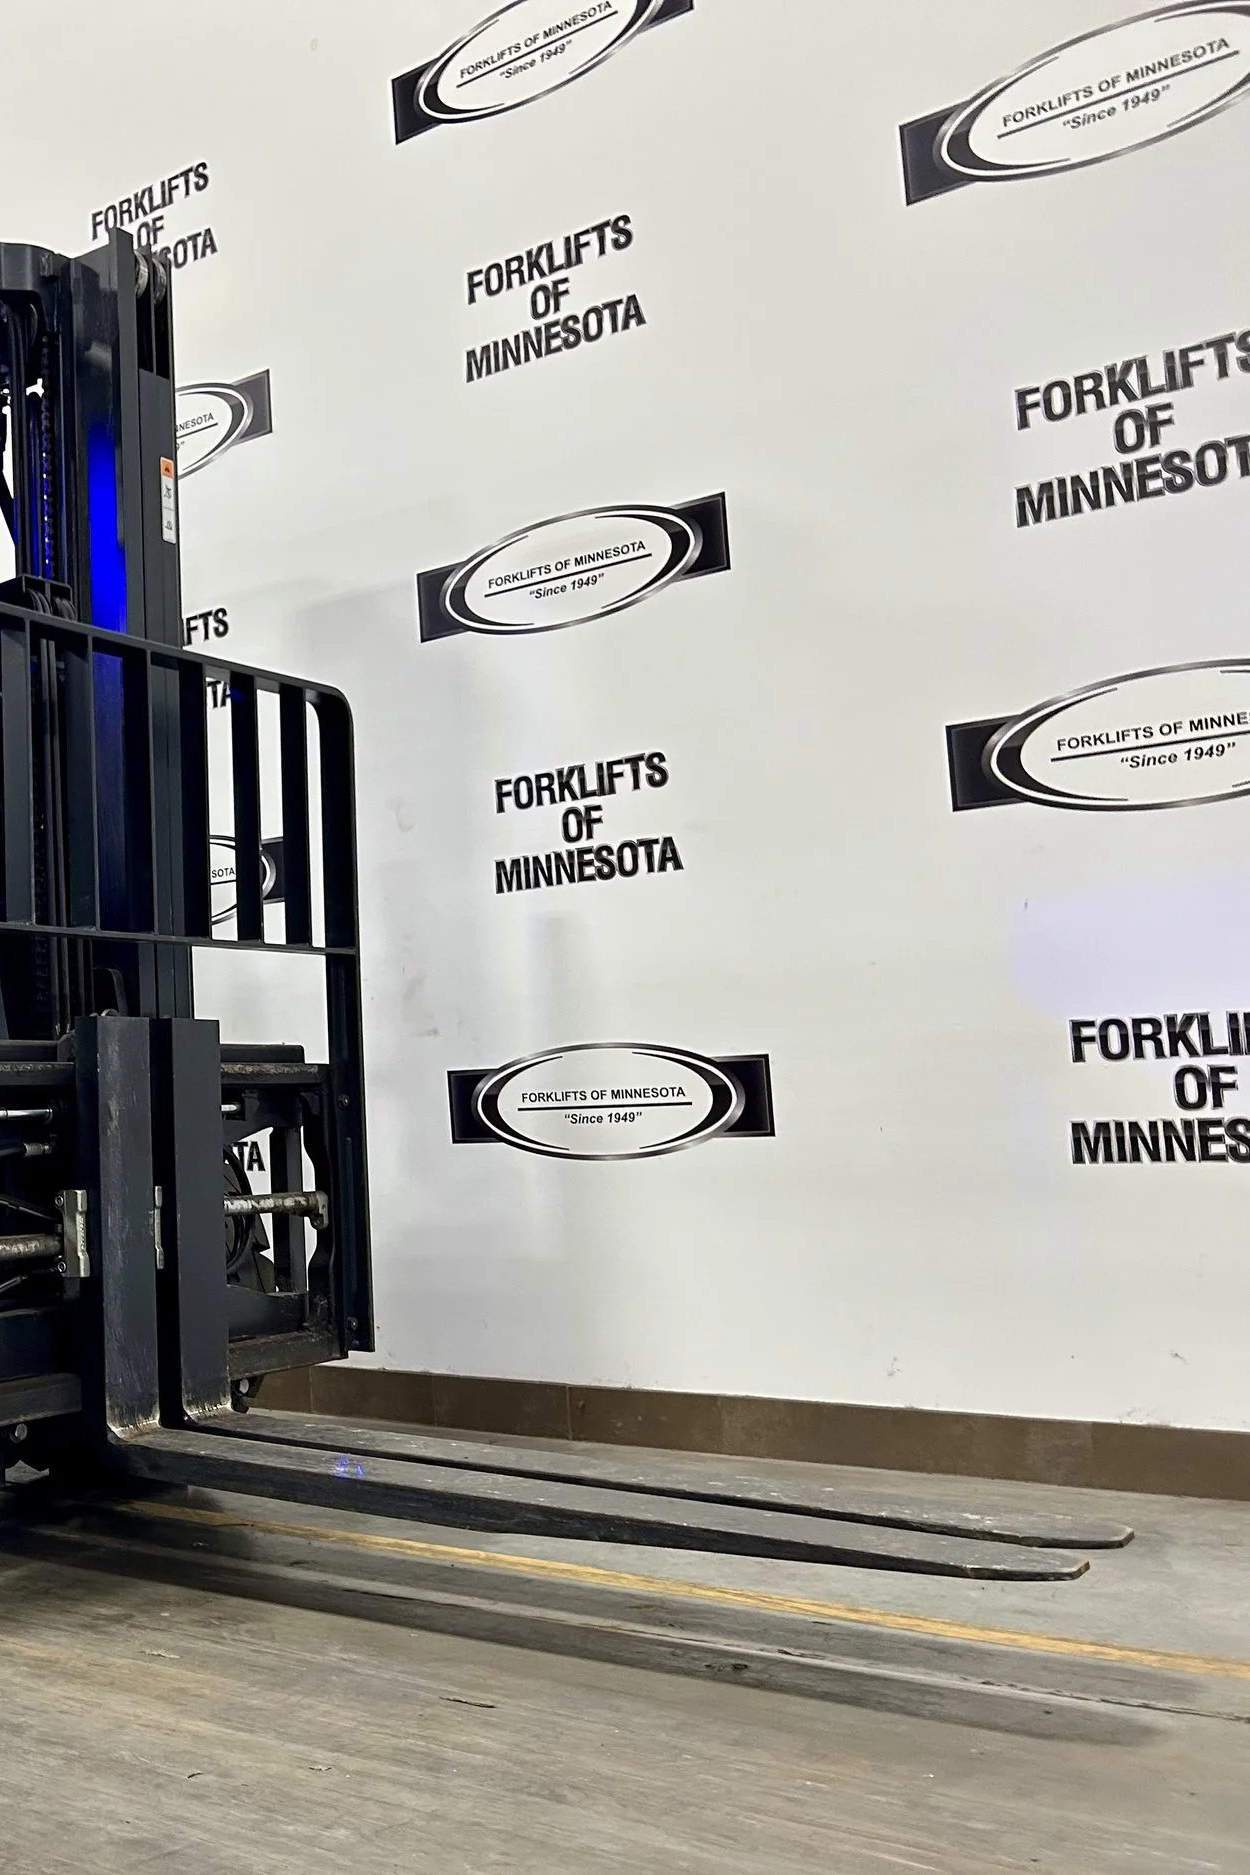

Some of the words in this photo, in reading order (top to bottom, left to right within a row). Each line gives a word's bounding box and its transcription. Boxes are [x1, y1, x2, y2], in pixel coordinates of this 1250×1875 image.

[459, 43, 522, 78] FORKLIFTS
[523, 33, 540, 48] OF
[542, 0, 613, 40] MINNESOTA
[1002, 85, 1094, 127] FORKLIFTS
[1097, 74, 1121, 92] OF
[1125, 37, 1230, 84] MINNESOTA
[1062, 106, 1117, 130] “Since
[91, 162, 209, 241] FORKLIFTS
[137, 215, 165, 248] OF
[467, 214, 634, 305] FORKLIFTS
[530, 276, 570, 320] OF
[465, 293, 647, 383] MINNESOTA
[1113, 401, 1175, 455] OF
[1014, 434, 1250, 528] MINNESOT
[488, 564, 552, 589] FORKLIFTS
[555, 559, 571, 571] OF
[574, 540, 646, 567] MINNESOTA
[529, 584, 567, 599] “Since
[570, 573, 604, 590] 1949”
[1057, 726, 1154, 751] FORKLIFTS
[1159, 721, 1183, 736] OF
[1189, 711, 1250, 732] MINNE
[1121, 753, 1178, 769] “Since
[1184, 742, 1236, 761] 1949”
[494, 752, 669, 814] FORKLIFTS
[561, 804, 603, 843] OF
[494, 836, 684, 894] MINNESOTA
[1069, 1011, 1250, 1063] FORKLI
[522, 1091, 587, 1103] FORKLIFTS
[590, 1089, 607, 1100] OF
[611, 1086, 686, 1100] MINNESOTA
[1174, 1064, 1238, 1110] OF
[564, 1113, 603, 1124] “Since
[607, 1111, 642, 1123] 1949”
[1070, 1116, 1250, 1164] MINNES
